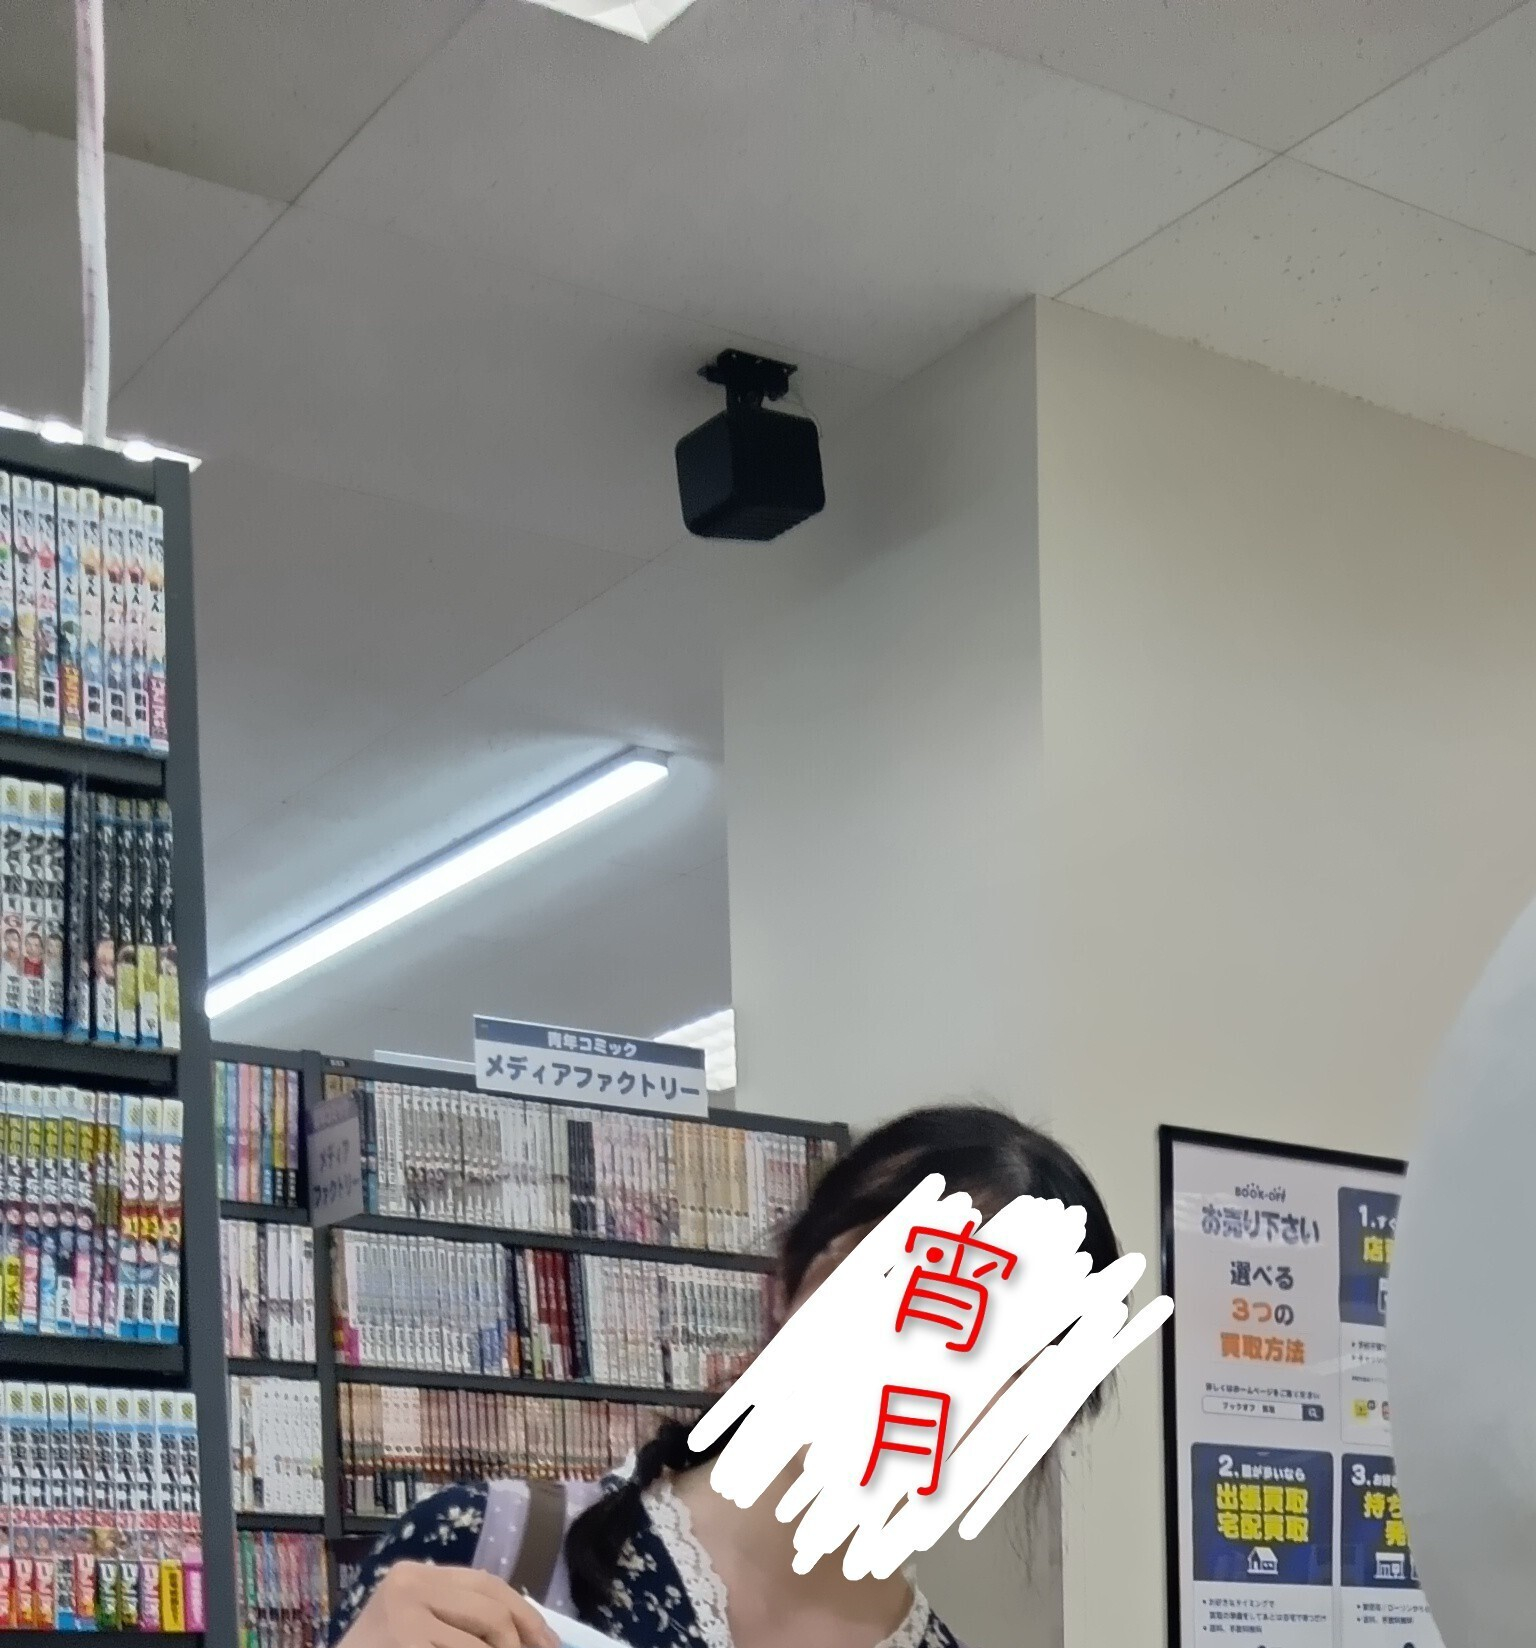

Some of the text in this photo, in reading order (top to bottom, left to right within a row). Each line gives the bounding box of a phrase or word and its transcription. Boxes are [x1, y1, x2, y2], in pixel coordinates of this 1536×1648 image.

[547, 1031, 637, 1057] 青年コミック
[486, 1054, 700, 1100] メディアファクトリー
[1202, 1203, 1319, 1245] お売り下さい
[1230, 1260, 1294, 1290] 選べる
[1231, 1297, 1294, 1326] 3つの
[1220, 1331, 1305, 1364] 買取方法
[1216, 1482, 1308, 1514] 出張買取
[1217, 1511, 1308, 1542] 宅配買取
